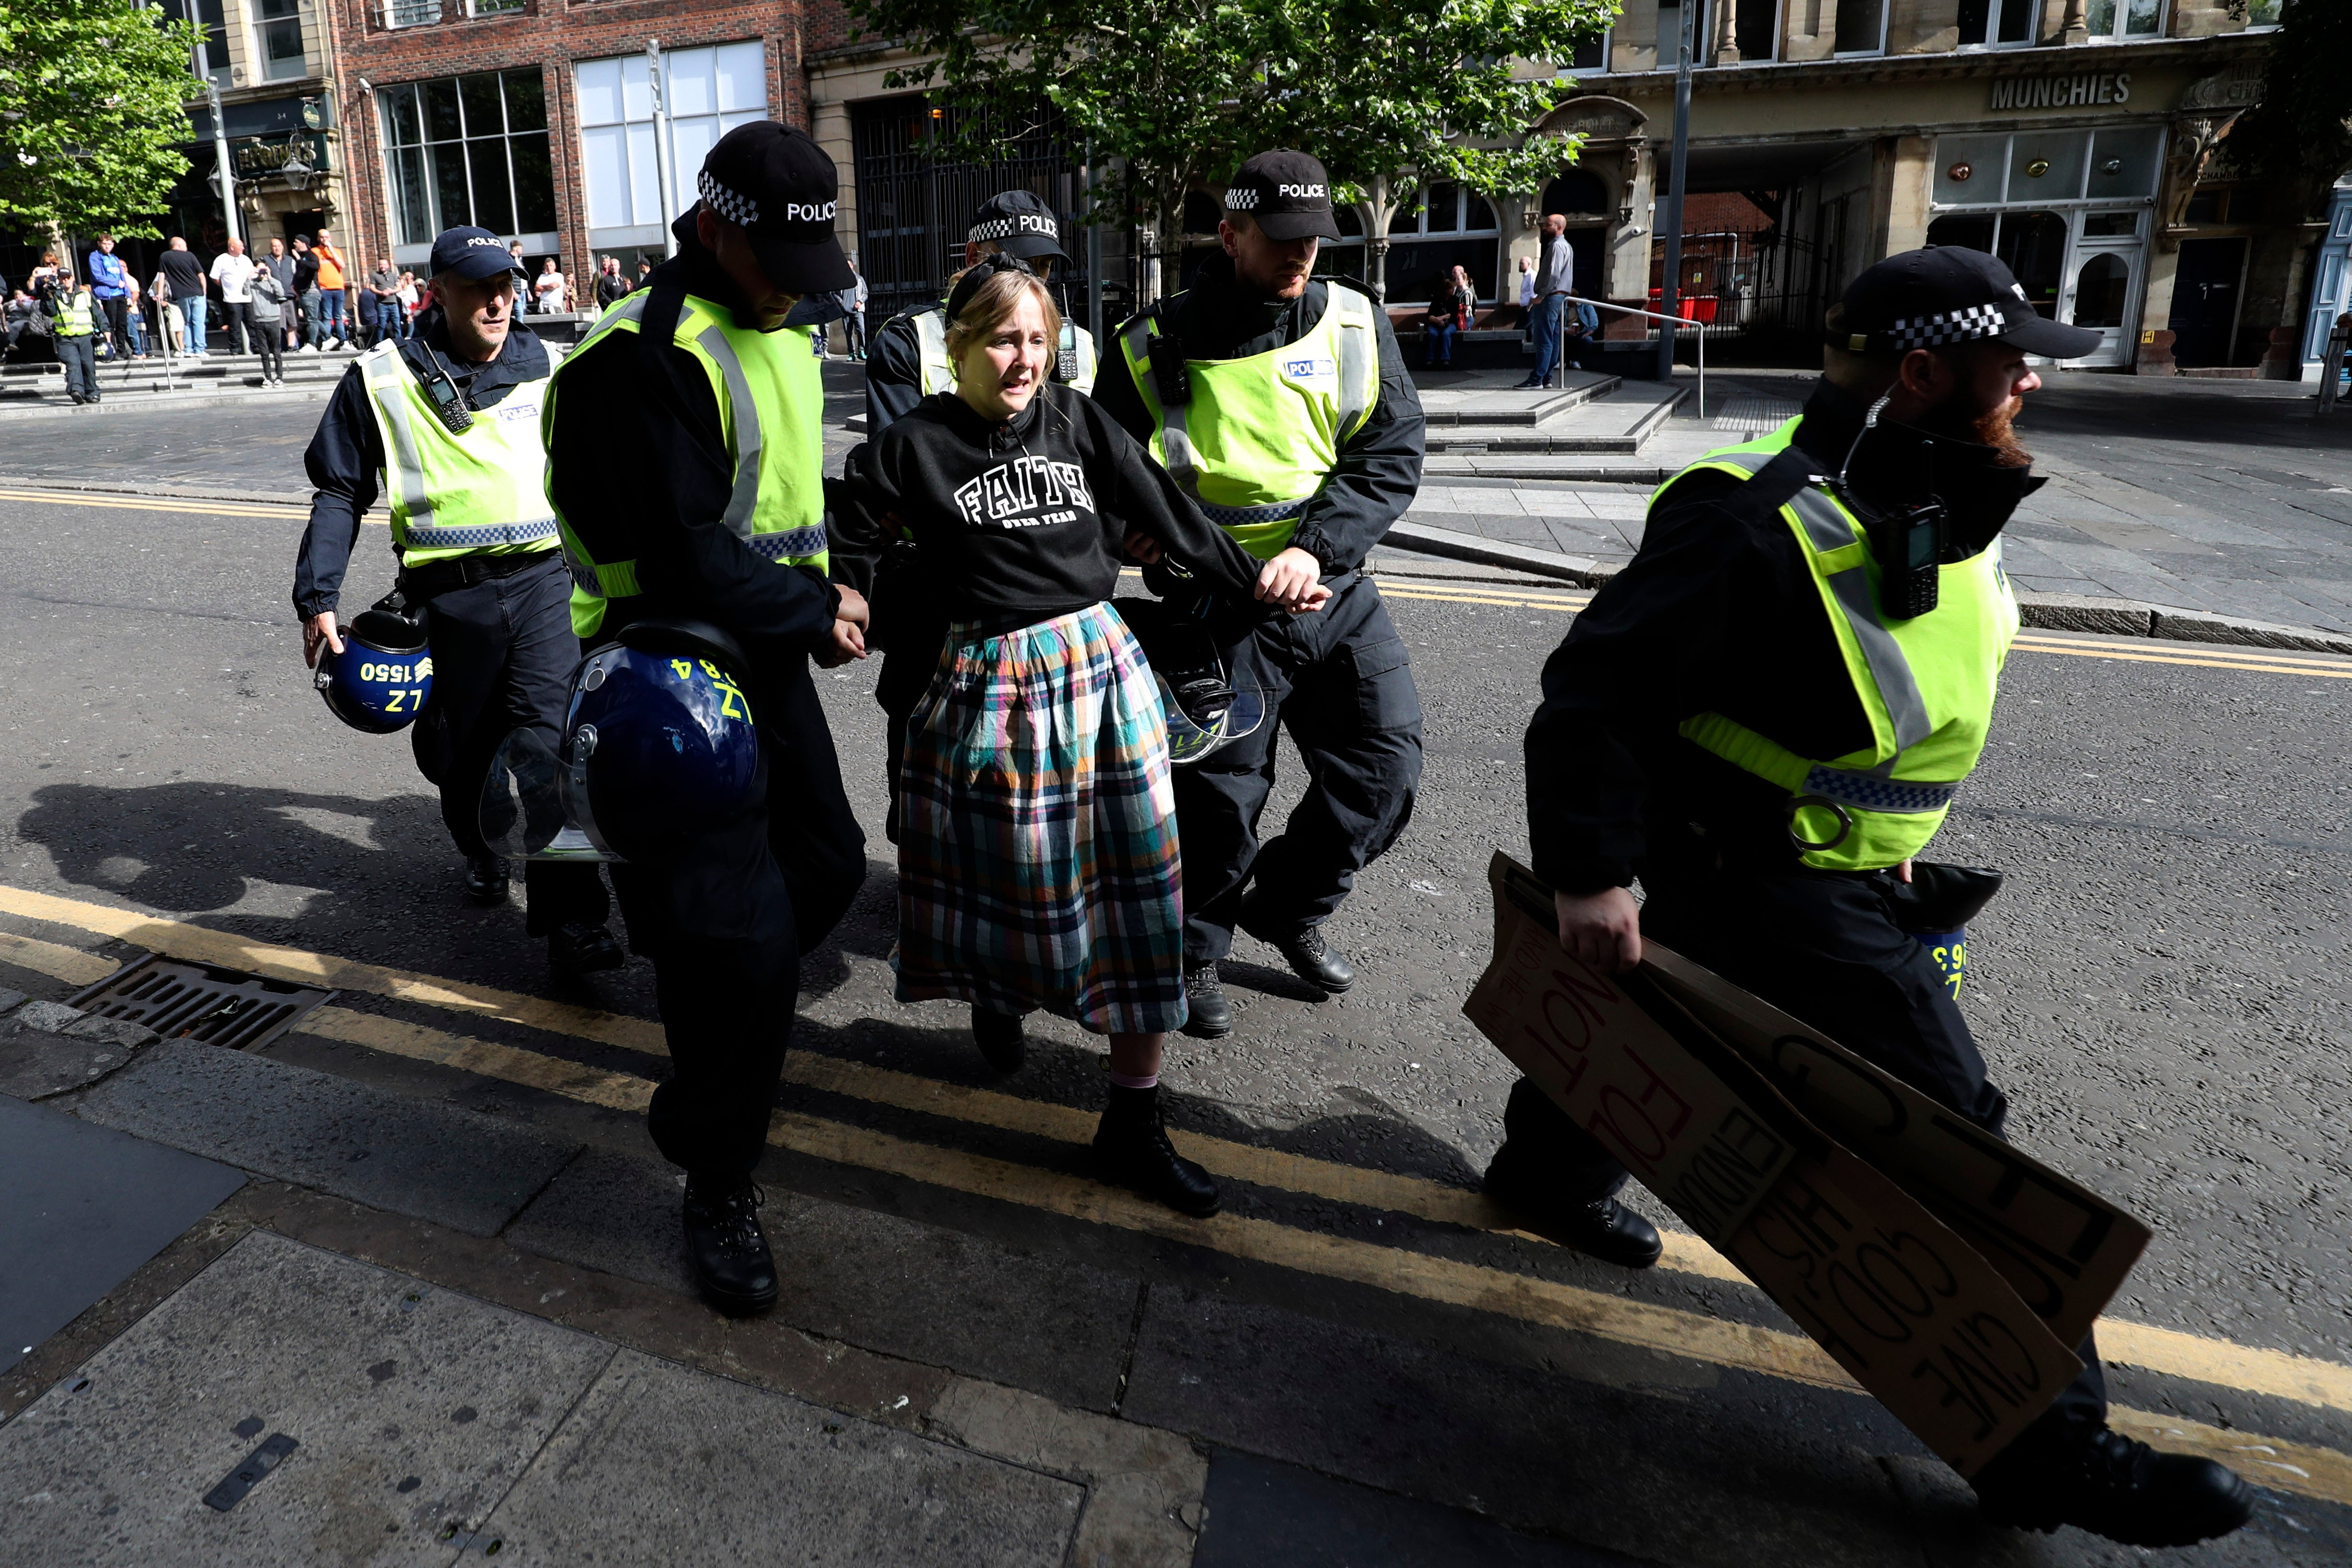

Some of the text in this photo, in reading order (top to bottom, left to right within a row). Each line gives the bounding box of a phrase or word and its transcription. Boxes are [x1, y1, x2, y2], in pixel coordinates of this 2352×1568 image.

[1991, 73, 2131, 109] MUNCHIES
[1278, 184, 1325, 197] POLICE
[1020, 215, 1057, 238] POLICE
[467, 237, 503, 248] POLICE
[954, 455, 1094, 526] FAITH
[1002, 510, 1077, 529] OVER FEAR
[361, 663, 412, 683] 1550
[385, 689, 423, 712] LZ
[713, 681, 754, 725] LZ
[1524, 949, 1619, 1095] NOT
[1750, 1171, 1853, 1279] HIS
[1911, 1311, 2041, 1442] GIVE
